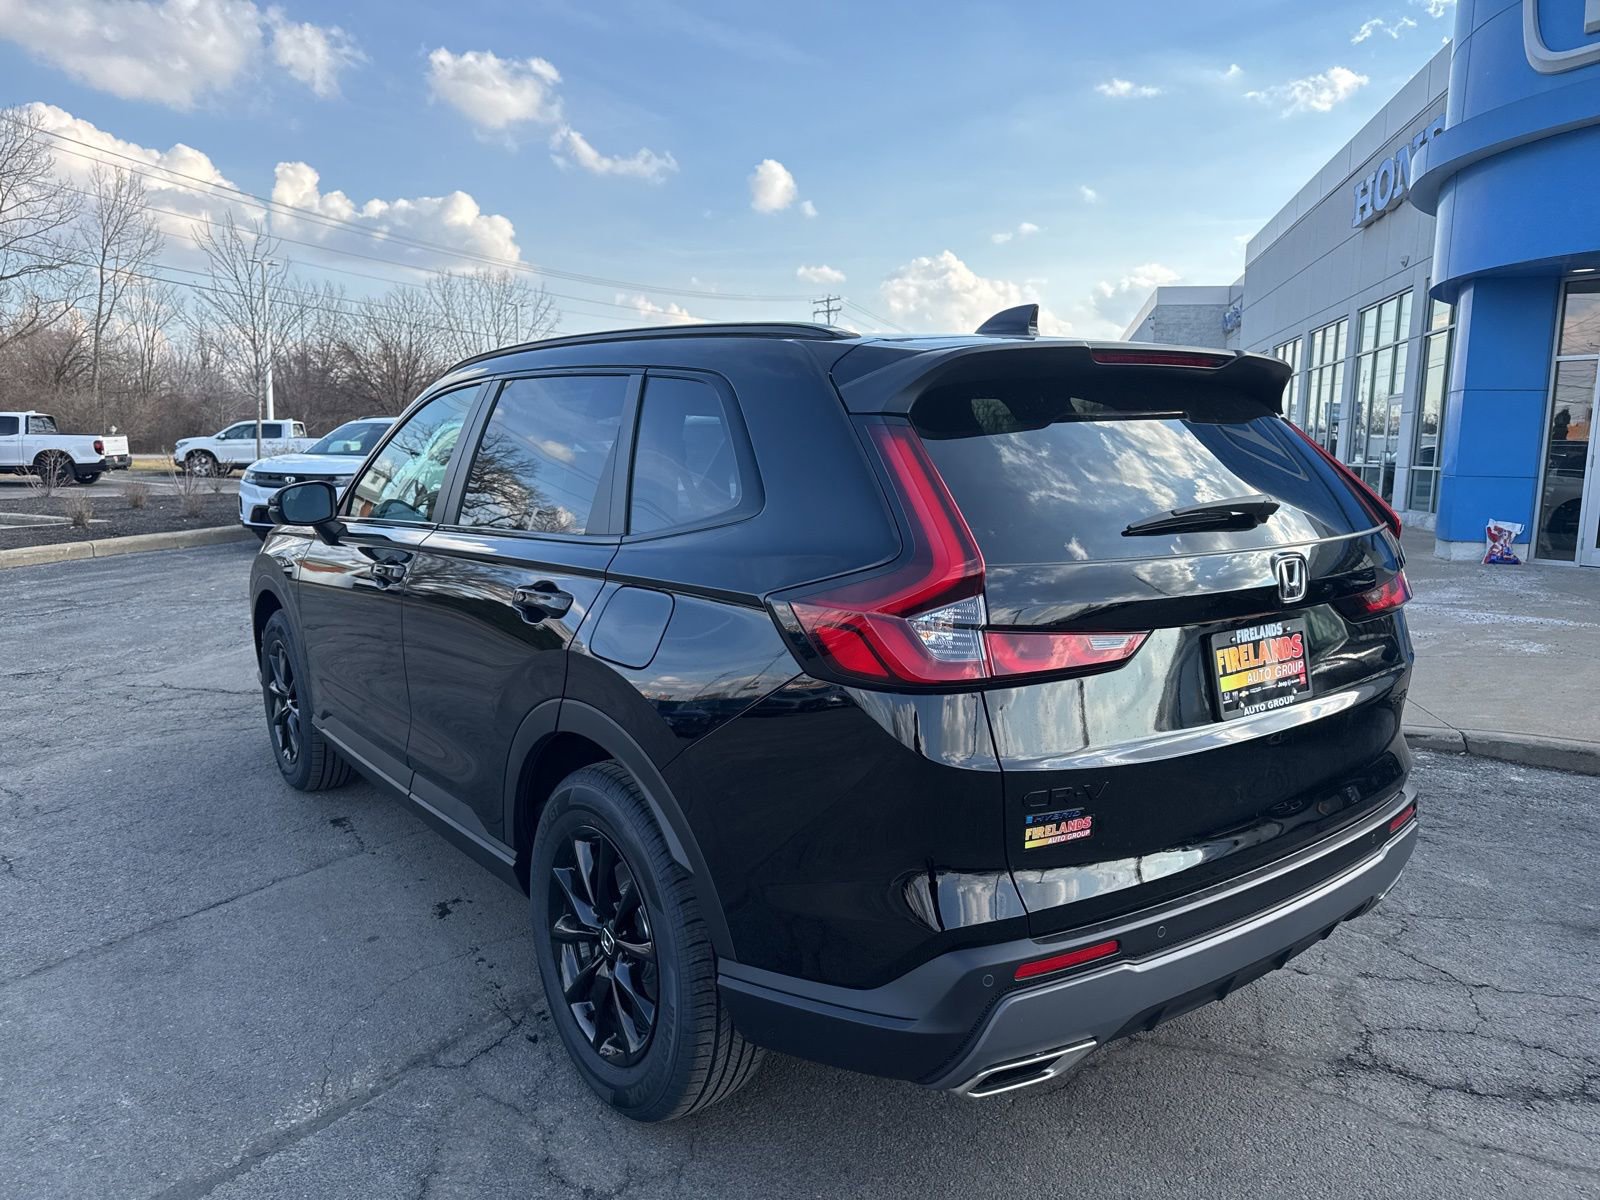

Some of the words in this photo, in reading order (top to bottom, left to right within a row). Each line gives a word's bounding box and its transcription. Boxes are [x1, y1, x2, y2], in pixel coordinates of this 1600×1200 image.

[1236, 622, 1283, 643] FIRELANDS
[1216, 633, 1304, 676] FIRELANDS
[1247, 668, 1272, 685] AUTO
[1275, 661, 1304, 677] GROUP
[1243, 703, 1266, 716] AUTO
[1267, 695, 1295, 709] GROUP
[1023, 780, 1111, 807] CR-V
[1025, 816, 1092, 841] FIRELANDS
[1047, 835, 1066, 844] AUTO
[1067, 829, 1091, 840] GROUP
